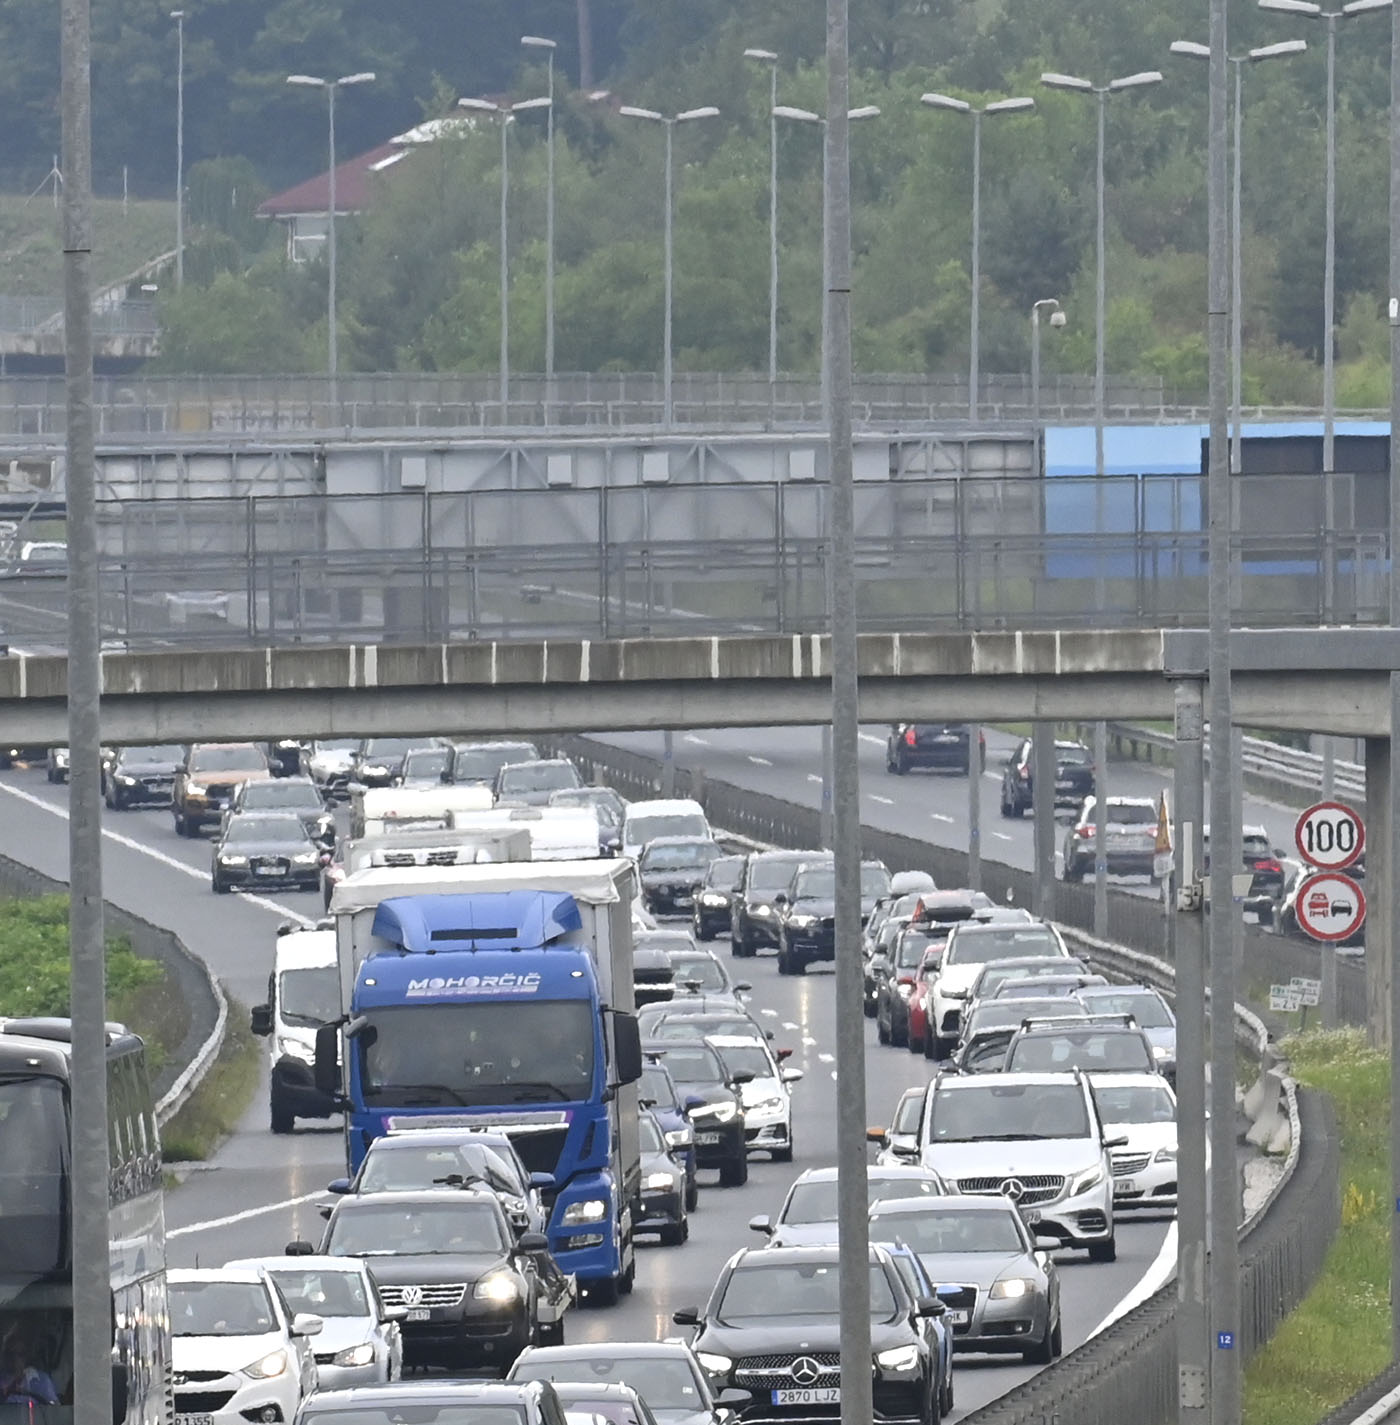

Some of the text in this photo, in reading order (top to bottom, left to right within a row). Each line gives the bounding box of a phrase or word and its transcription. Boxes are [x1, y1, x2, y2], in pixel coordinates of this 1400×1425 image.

[1306, 819, 1353, 852] 100
[1220, 1335, 1231, 1344] 12
[781, 1391, 810, 1402] 2870
